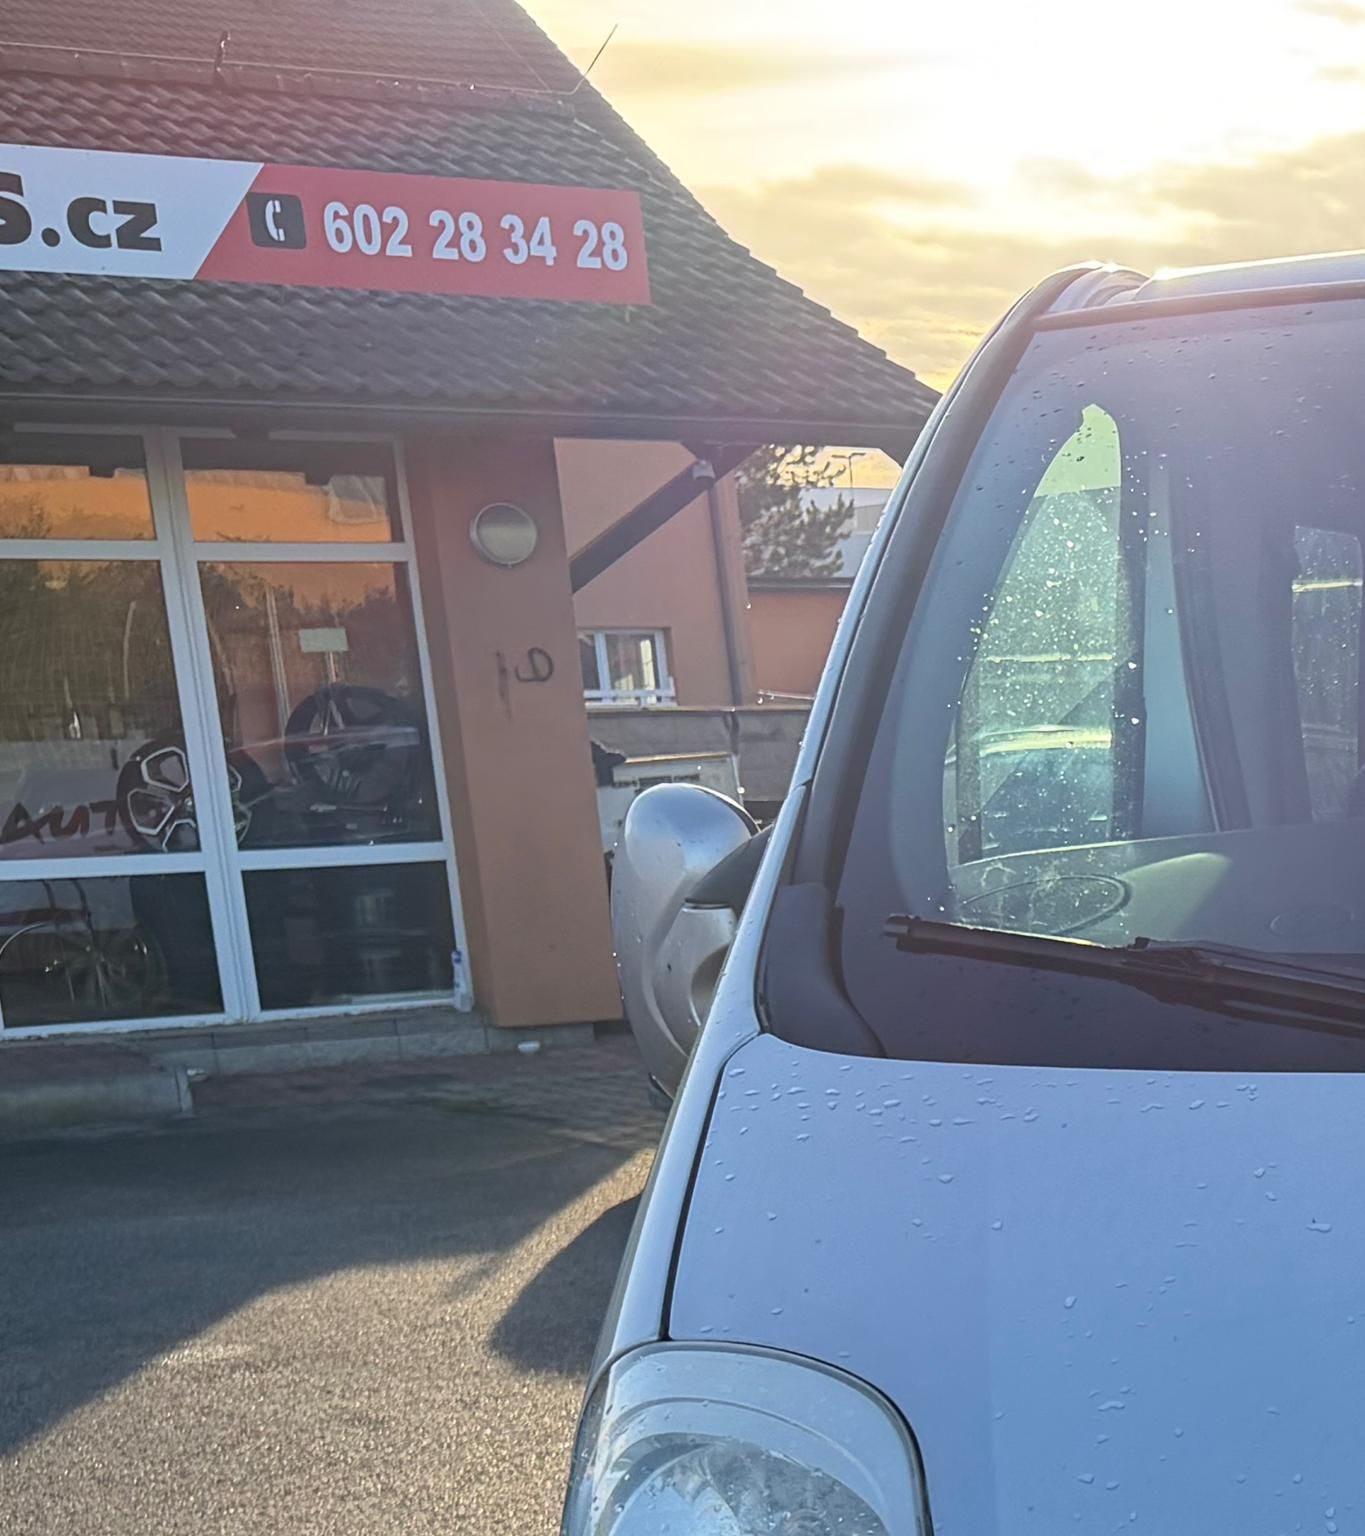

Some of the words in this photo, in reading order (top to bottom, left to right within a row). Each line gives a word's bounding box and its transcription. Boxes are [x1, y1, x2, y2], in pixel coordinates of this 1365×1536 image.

[323, 201, 413, 257] 602
[429, 209, 487, 263] 28
[500, 214, 557, 266] 34
[573, 219, 629, 271] 28
